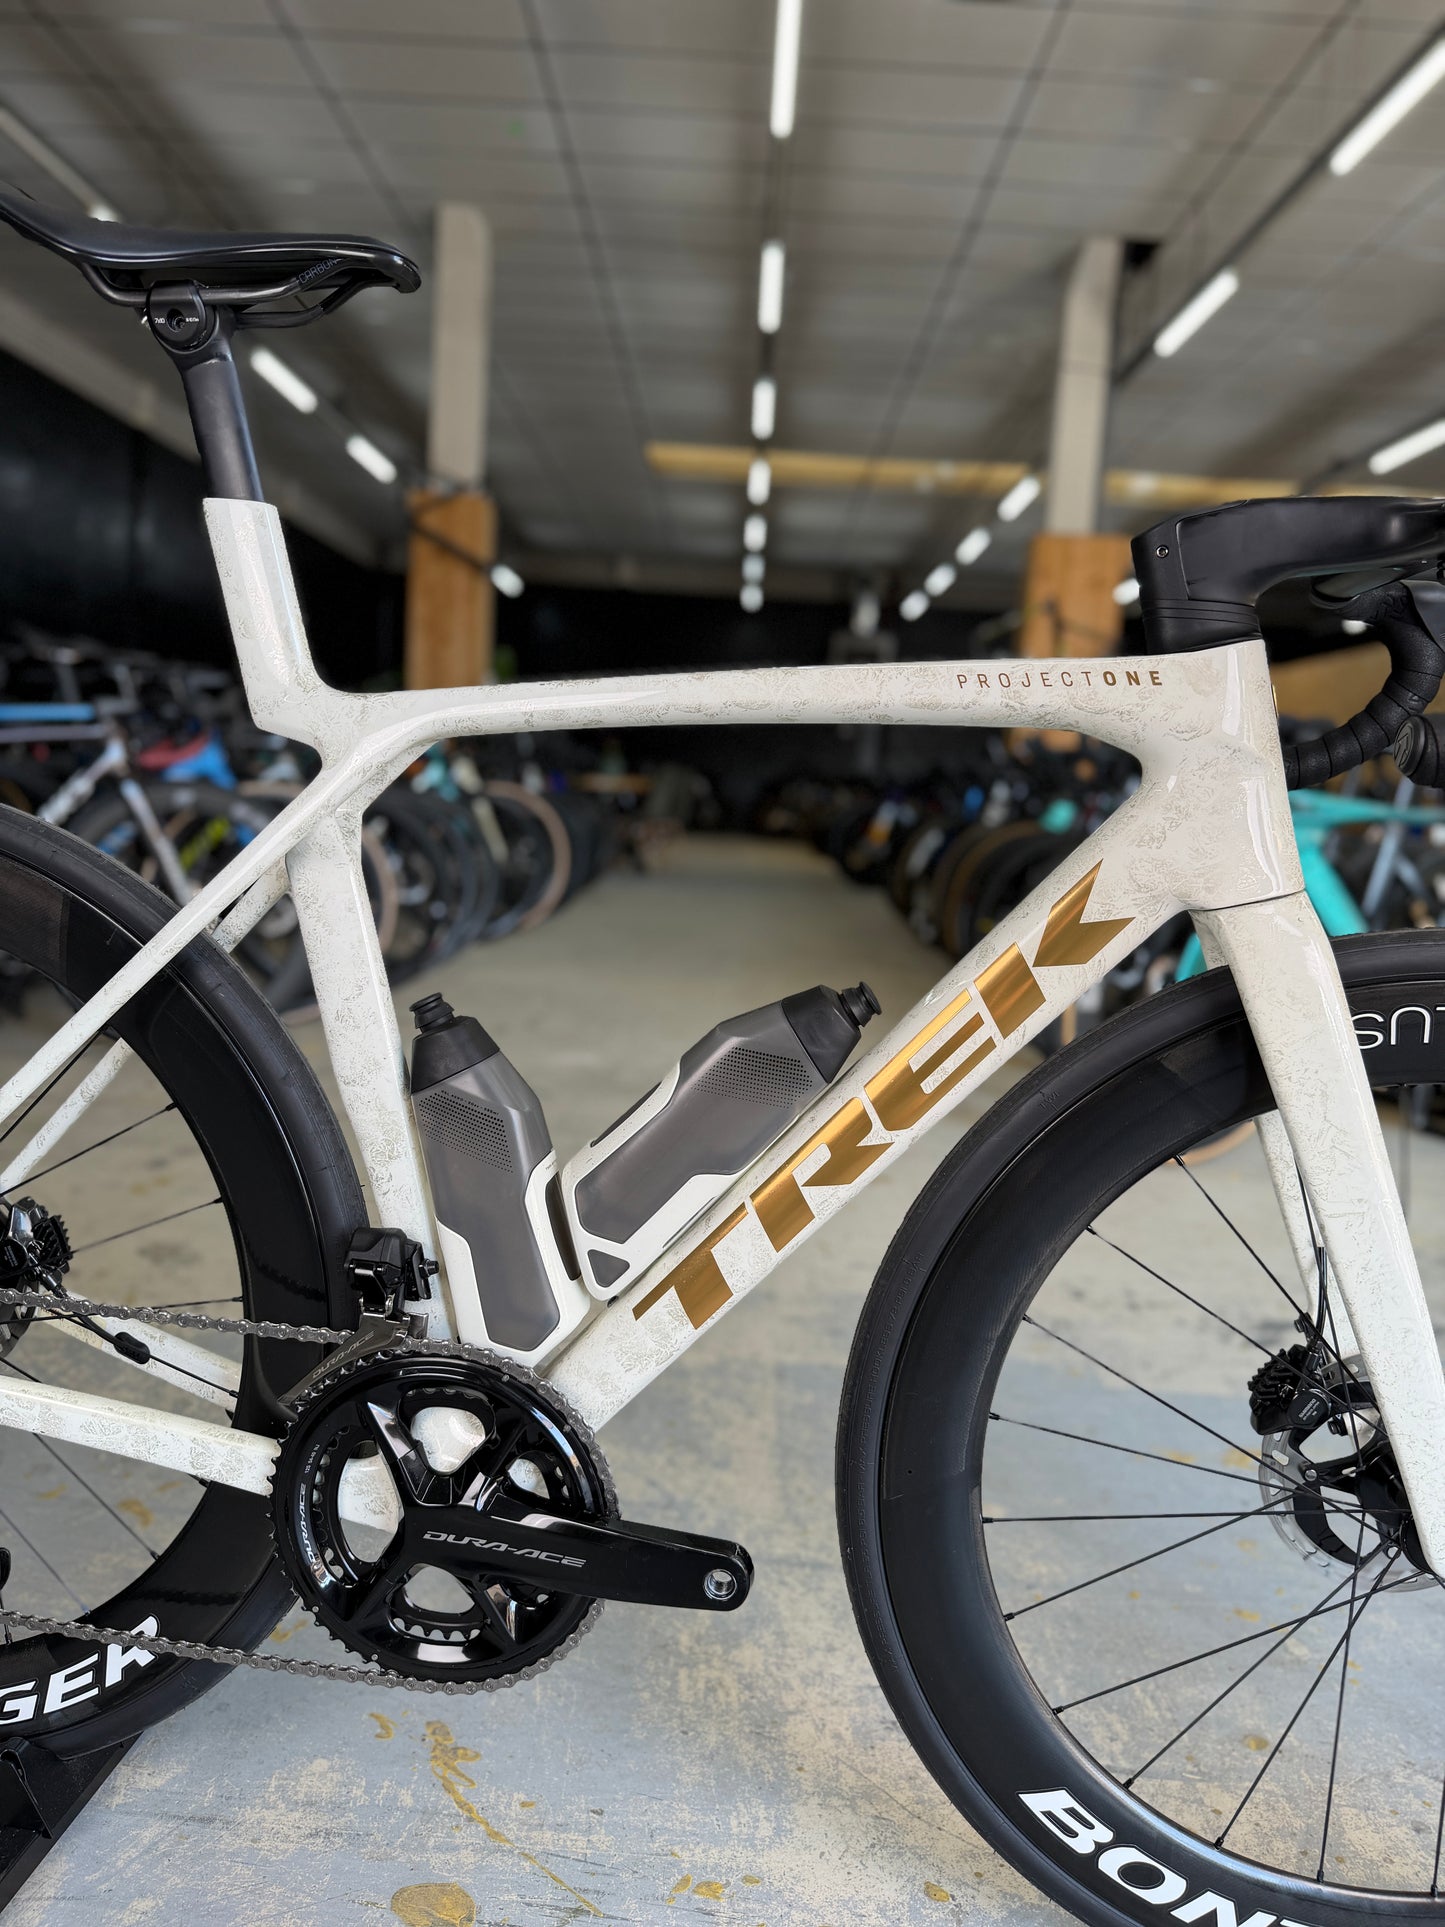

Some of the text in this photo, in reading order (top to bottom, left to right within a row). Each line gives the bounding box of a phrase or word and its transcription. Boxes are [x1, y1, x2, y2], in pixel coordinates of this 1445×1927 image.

[299, 258, 338, 283] CARBON
[632, 858, 1135, 1330] TREK
[312, 1329, 376, 1379] DURA-ACE
[299, 1483, 317, 1563] DURA-ACE
[423, 1531, 587, 1568] DURA-ACE
